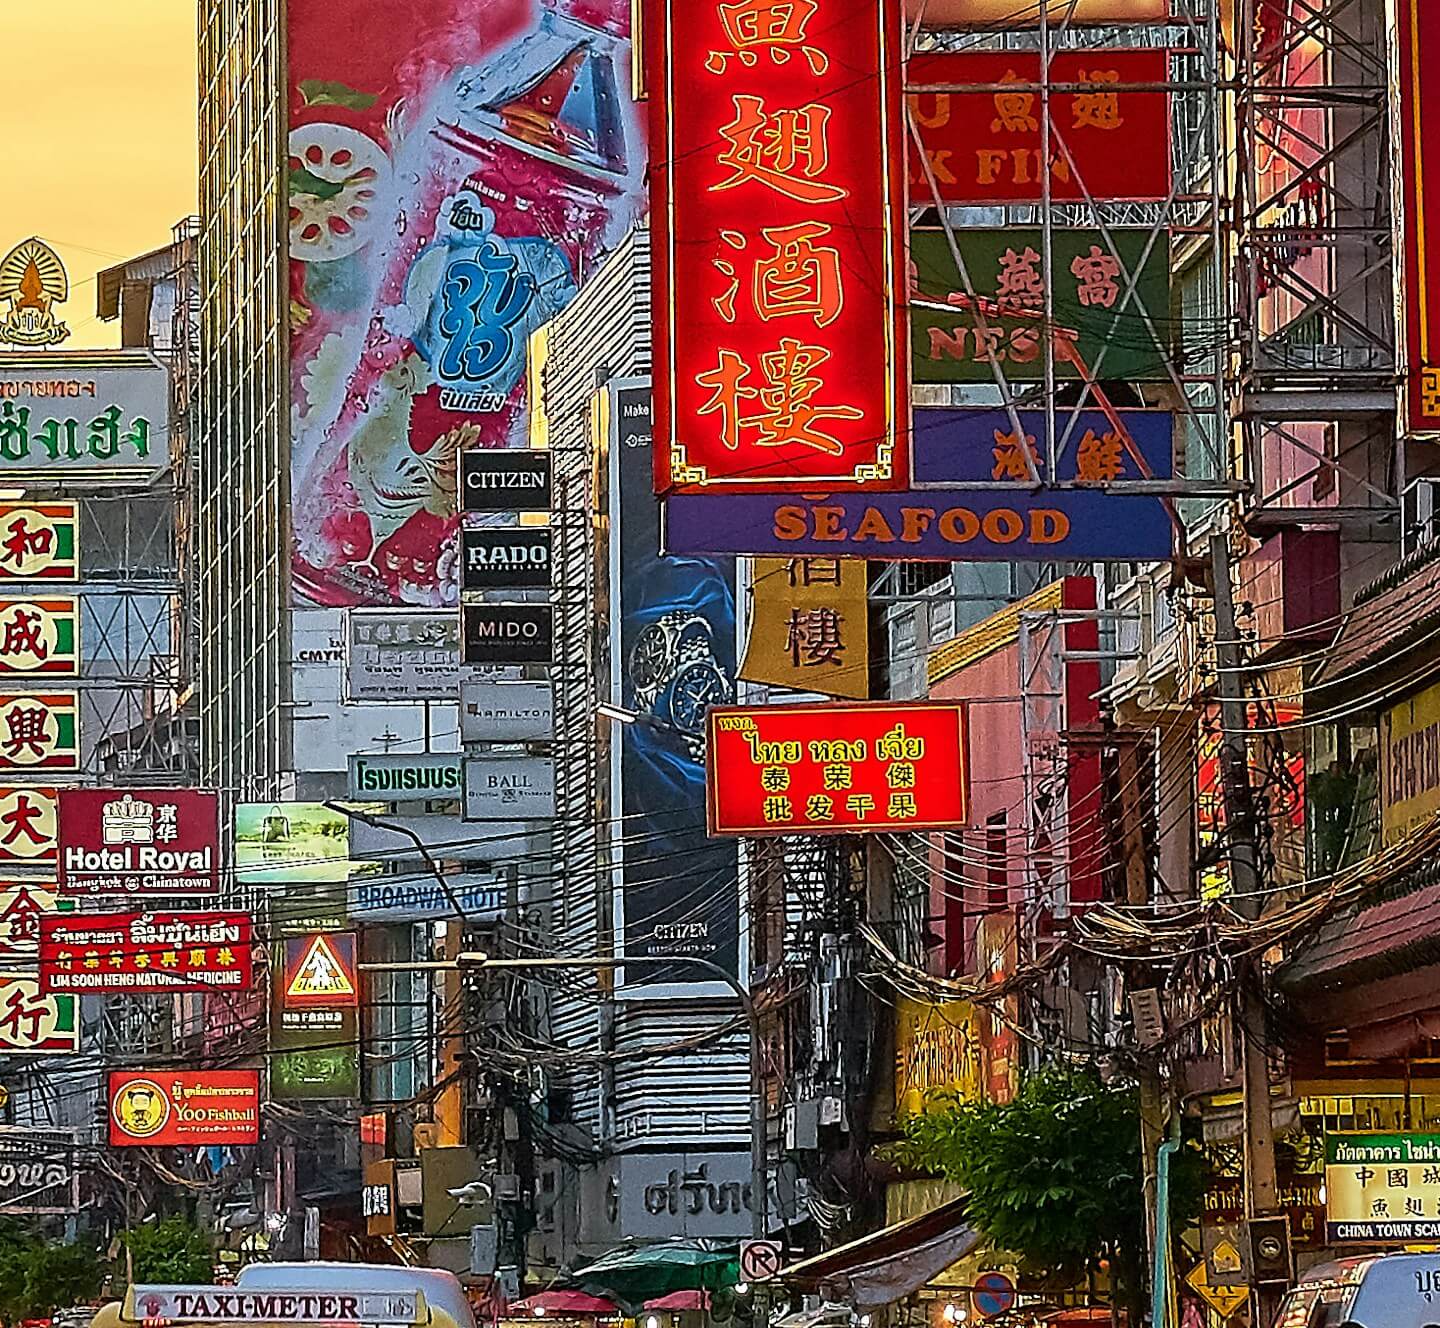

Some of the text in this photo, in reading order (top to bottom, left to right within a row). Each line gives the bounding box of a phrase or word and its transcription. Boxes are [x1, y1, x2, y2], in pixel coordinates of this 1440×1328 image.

[467, 472, 545, 488] CITIZEN
[773, 508, 1070, 544] SEAFOOD
[468, 546, 547, 564] RADO
[479, 621, 538, 637] MIDO
[743, 731, 801, 763] ไทย
[810, 739, 866, 763] หลง
[488, 775, 533, 788] BALL
[66, 847, 211, 872] Hotel Royal
[143, 876, 211, 888] Chinatown
[72, 974, 102, 987] SOON
[104, 974, 134, 986] HENG
[207, 1108, 255, 1121] Fishball
[1337, 1223, 1373, 1238] CHINA
[1376, 1223, 1412, 1238] TOWN
[173, 1295, 361, 1319] TAXI-METER
